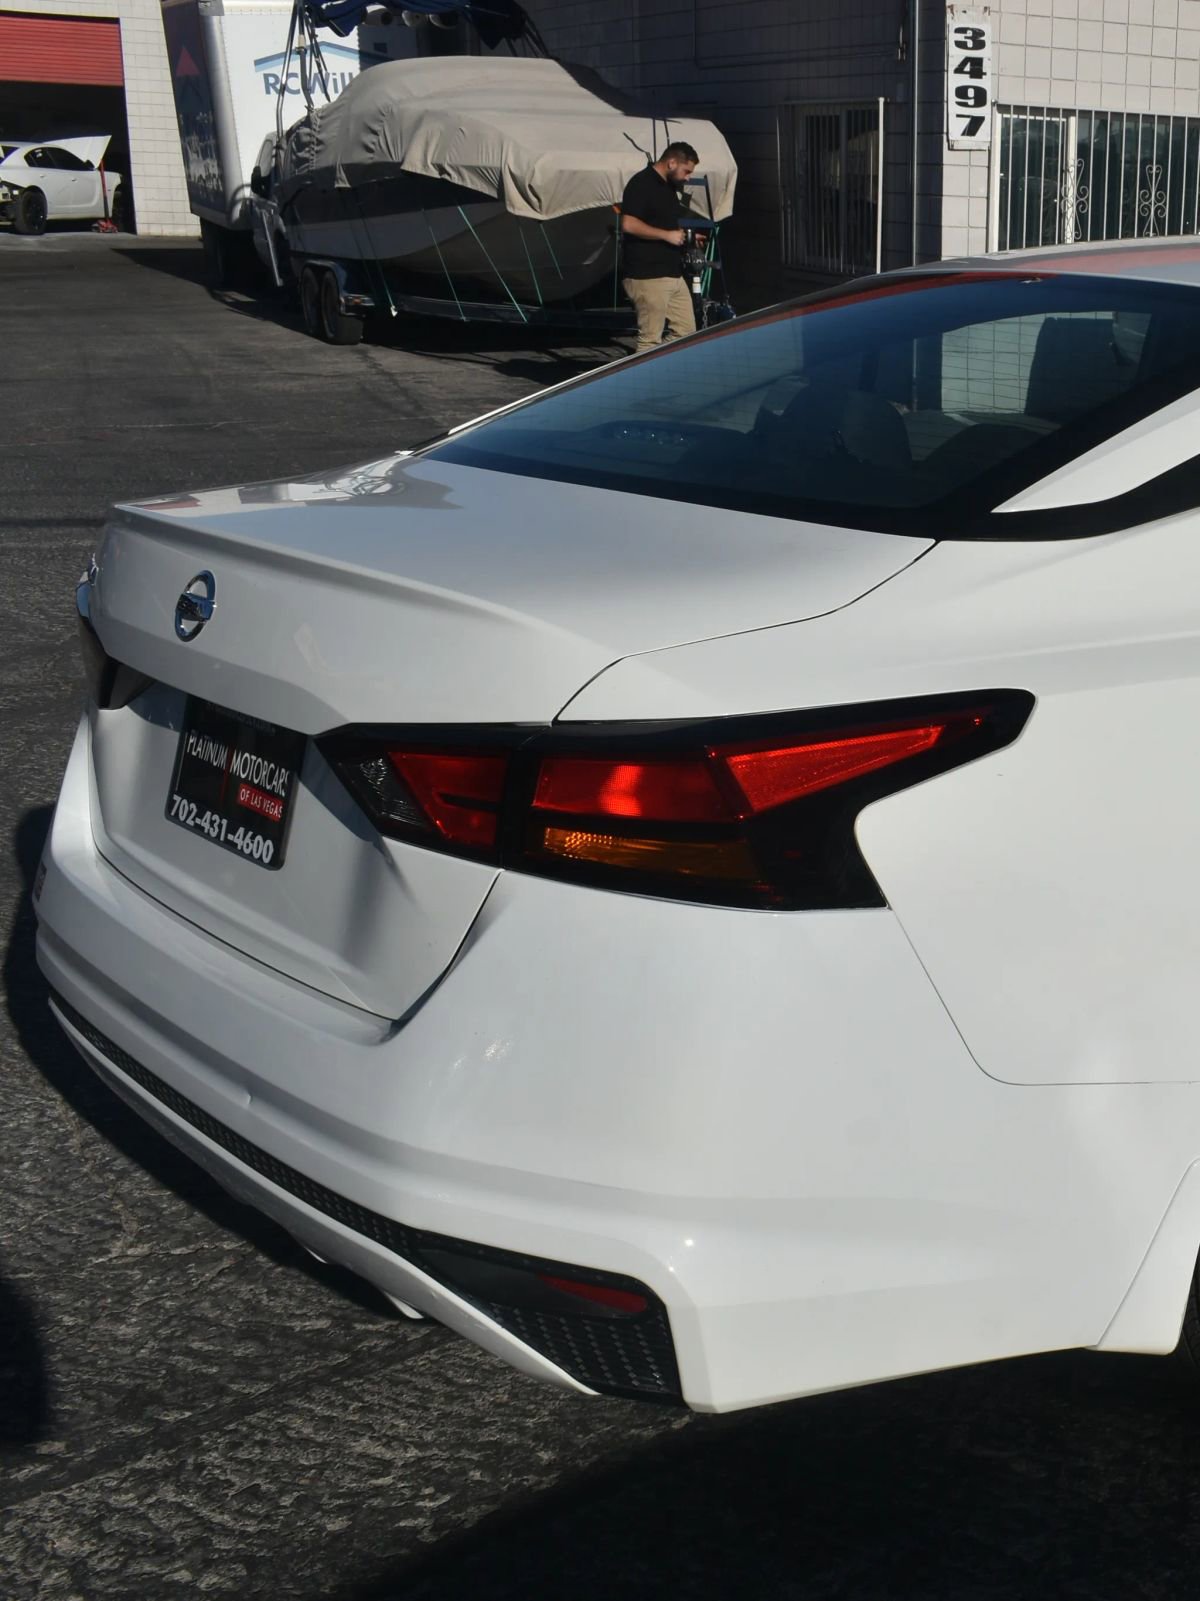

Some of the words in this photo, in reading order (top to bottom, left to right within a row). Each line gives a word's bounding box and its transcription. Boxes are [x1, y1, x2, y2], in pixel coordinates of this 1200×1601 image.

[953, 26, 987, 137] 3497
[186, 733, 228, 770] PLATINUM
[229, 749, 290, 797] MOTORCARS
[170, 794, 274, 864] 702-431-4600
[240, 788, 250, 801] OF
[250, 793, 262, 809] LAS
[262, 797, 283, 819] VEGAS
